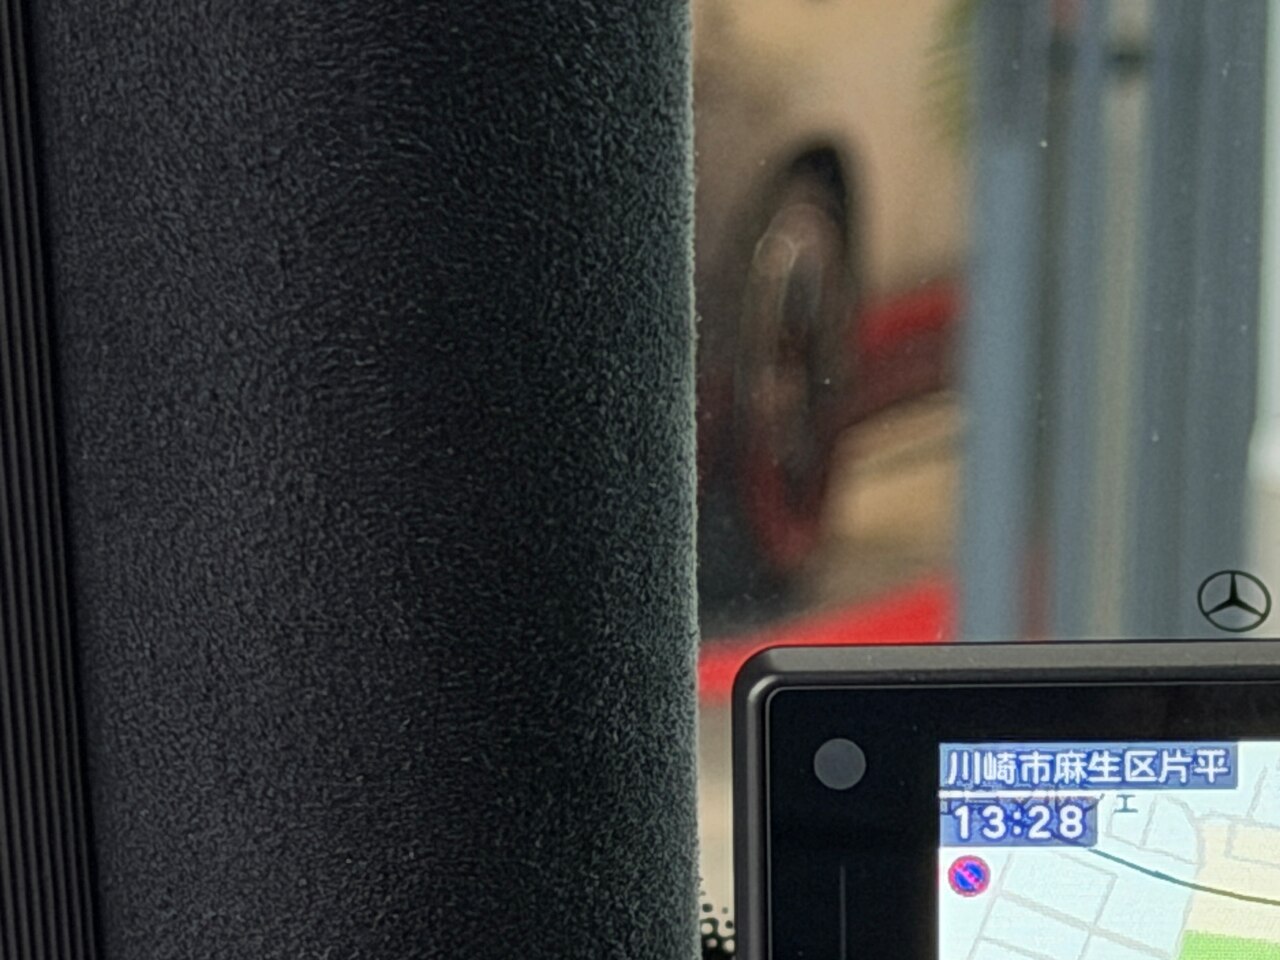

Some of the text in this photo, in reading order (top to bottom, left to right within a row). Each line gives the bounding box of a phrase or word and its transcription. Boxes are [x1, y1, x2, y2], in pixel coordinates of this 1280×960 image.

[948, 750, 1229, 785] 川崎市麻生区片平
[954, 804, 1083, 839] 13:28
